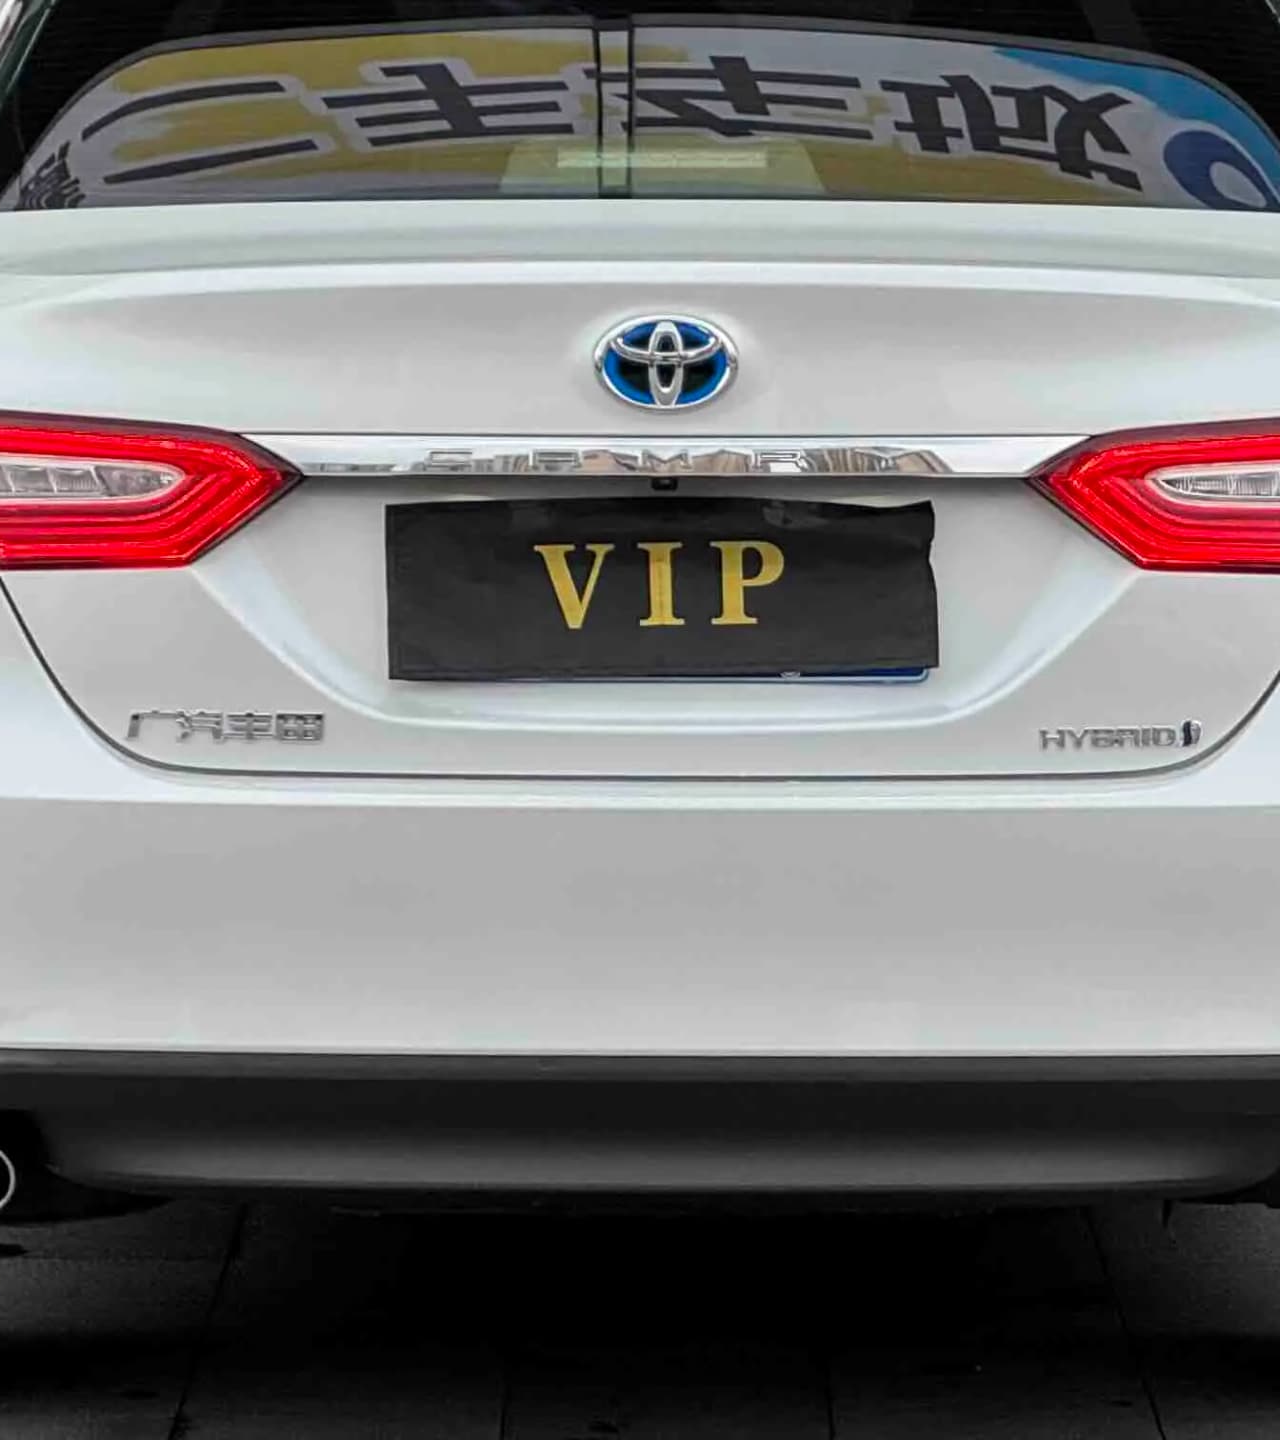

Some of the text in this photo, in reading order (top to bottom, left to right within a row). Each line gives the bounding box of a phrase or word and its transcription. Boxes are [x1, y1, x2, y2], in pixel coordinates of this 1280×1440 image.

[533, 540, 785, 630] VIP
[126, 710, 325, 744] 广汽丰田
[1038, 726, 1178, 751] HYBRID
